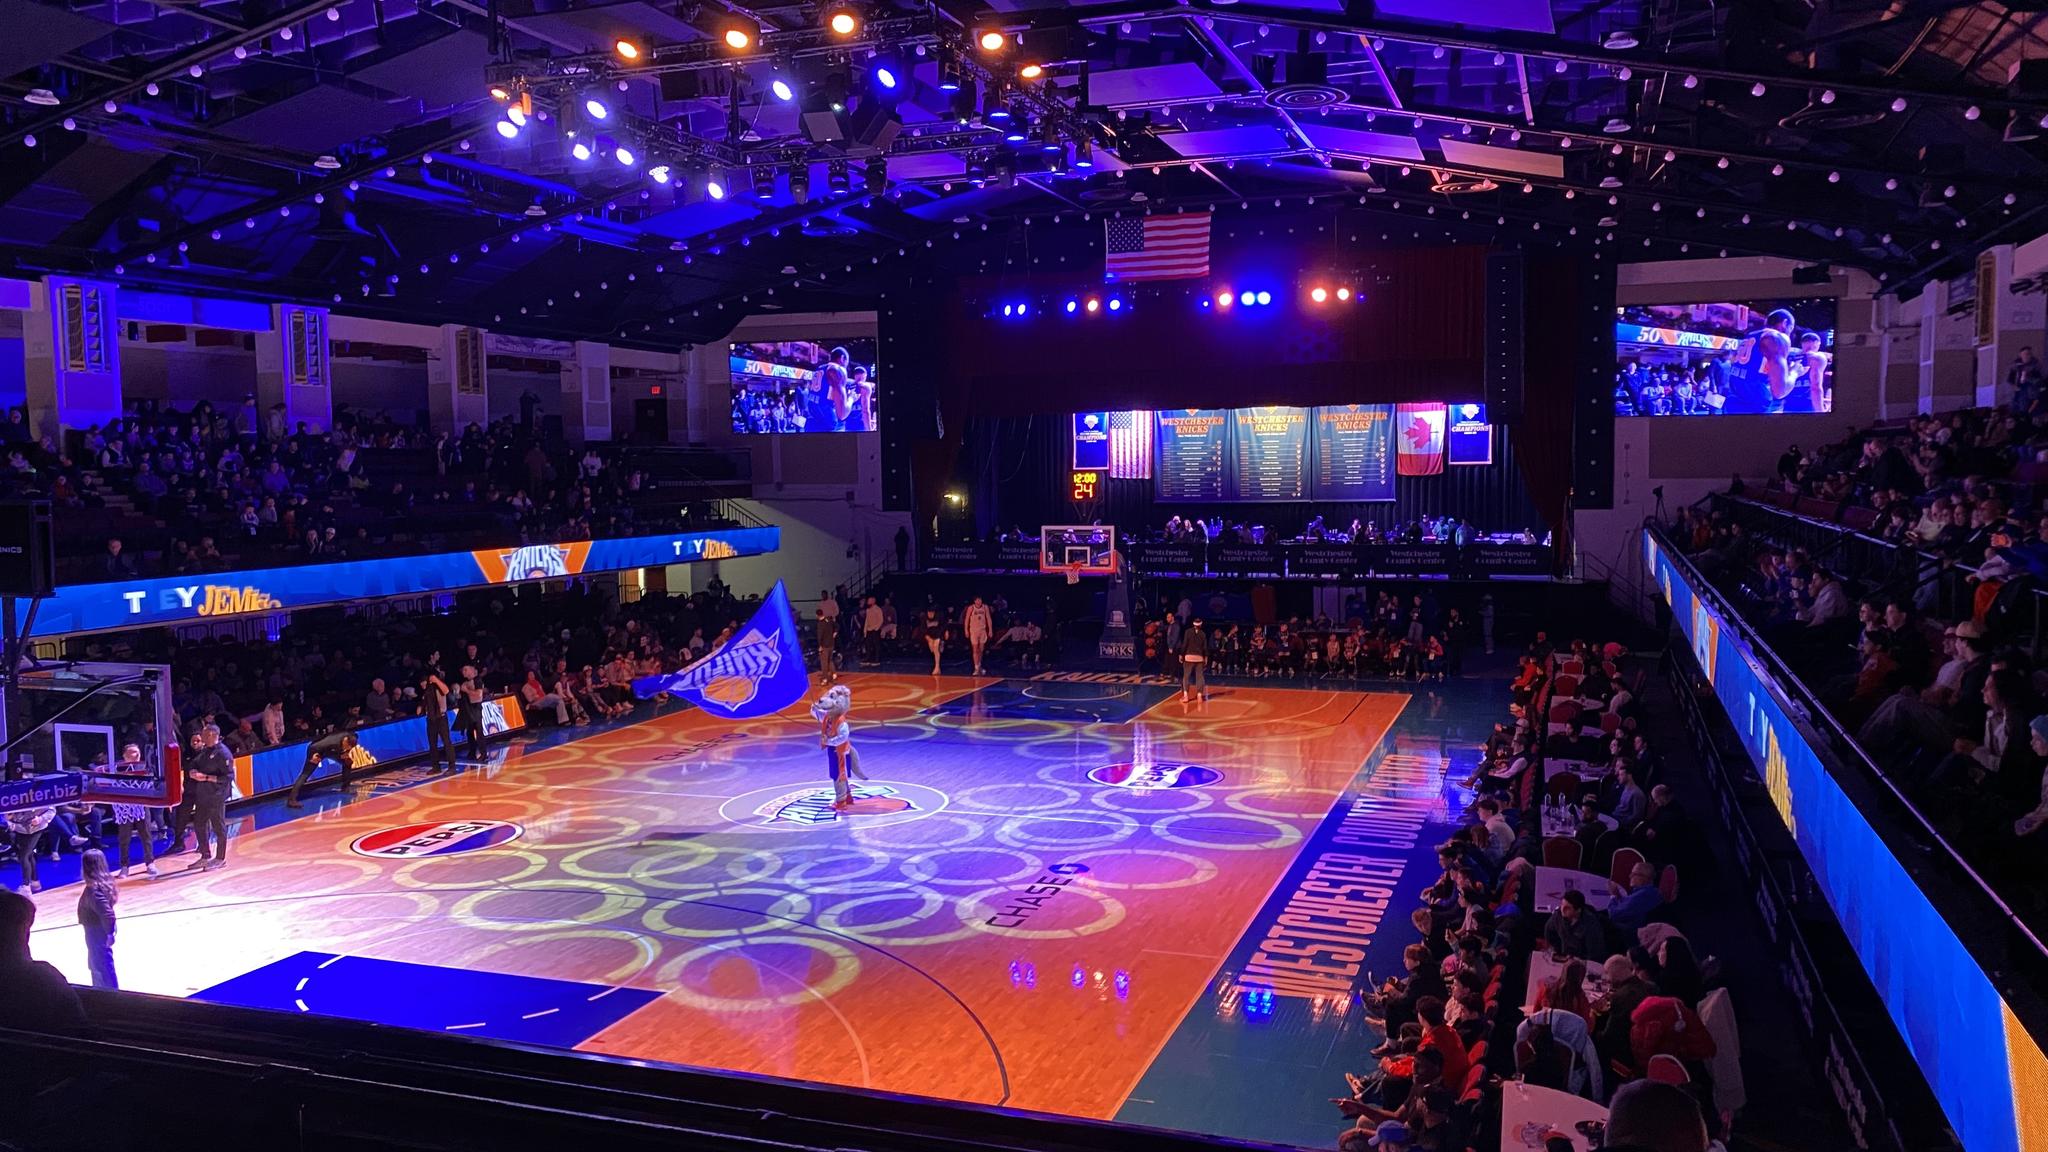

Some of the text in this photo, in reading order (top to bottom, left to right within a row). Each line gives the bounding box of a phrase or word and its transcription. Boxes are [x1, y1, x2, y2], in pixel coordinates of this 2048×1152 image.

[1637, 327, 1660, 342] 50
[1725, 338, 1739, 350] 50
[744, 360, 760, 374] 50
[1161, 416, 1225, 426] WESTCHESTER
[1238, 415, 1305, 425] WESTCHESTER
[1320, 412, 1389, 423] WESTCHESTER
[1176, 425, 1209, 434] KNICKS
[1254, 423, 1289, 433] KNICKS
[1335, 420, 1372, 431] KNICKS
[1073, 472, 1097, 484] 12:00
[1074, 484, 1093, 499] 24
[504, 545, 566, 581] KNICKS
[1128, 763, 1181, 787] PEPSI
[378, 821, 494, 855] PEPSI
[985, 876, 1073, 928] CHASE
[1232, 852, 1408, 999] WESTCHESTER
[1332, 793, 1434, 849] COUNTY
